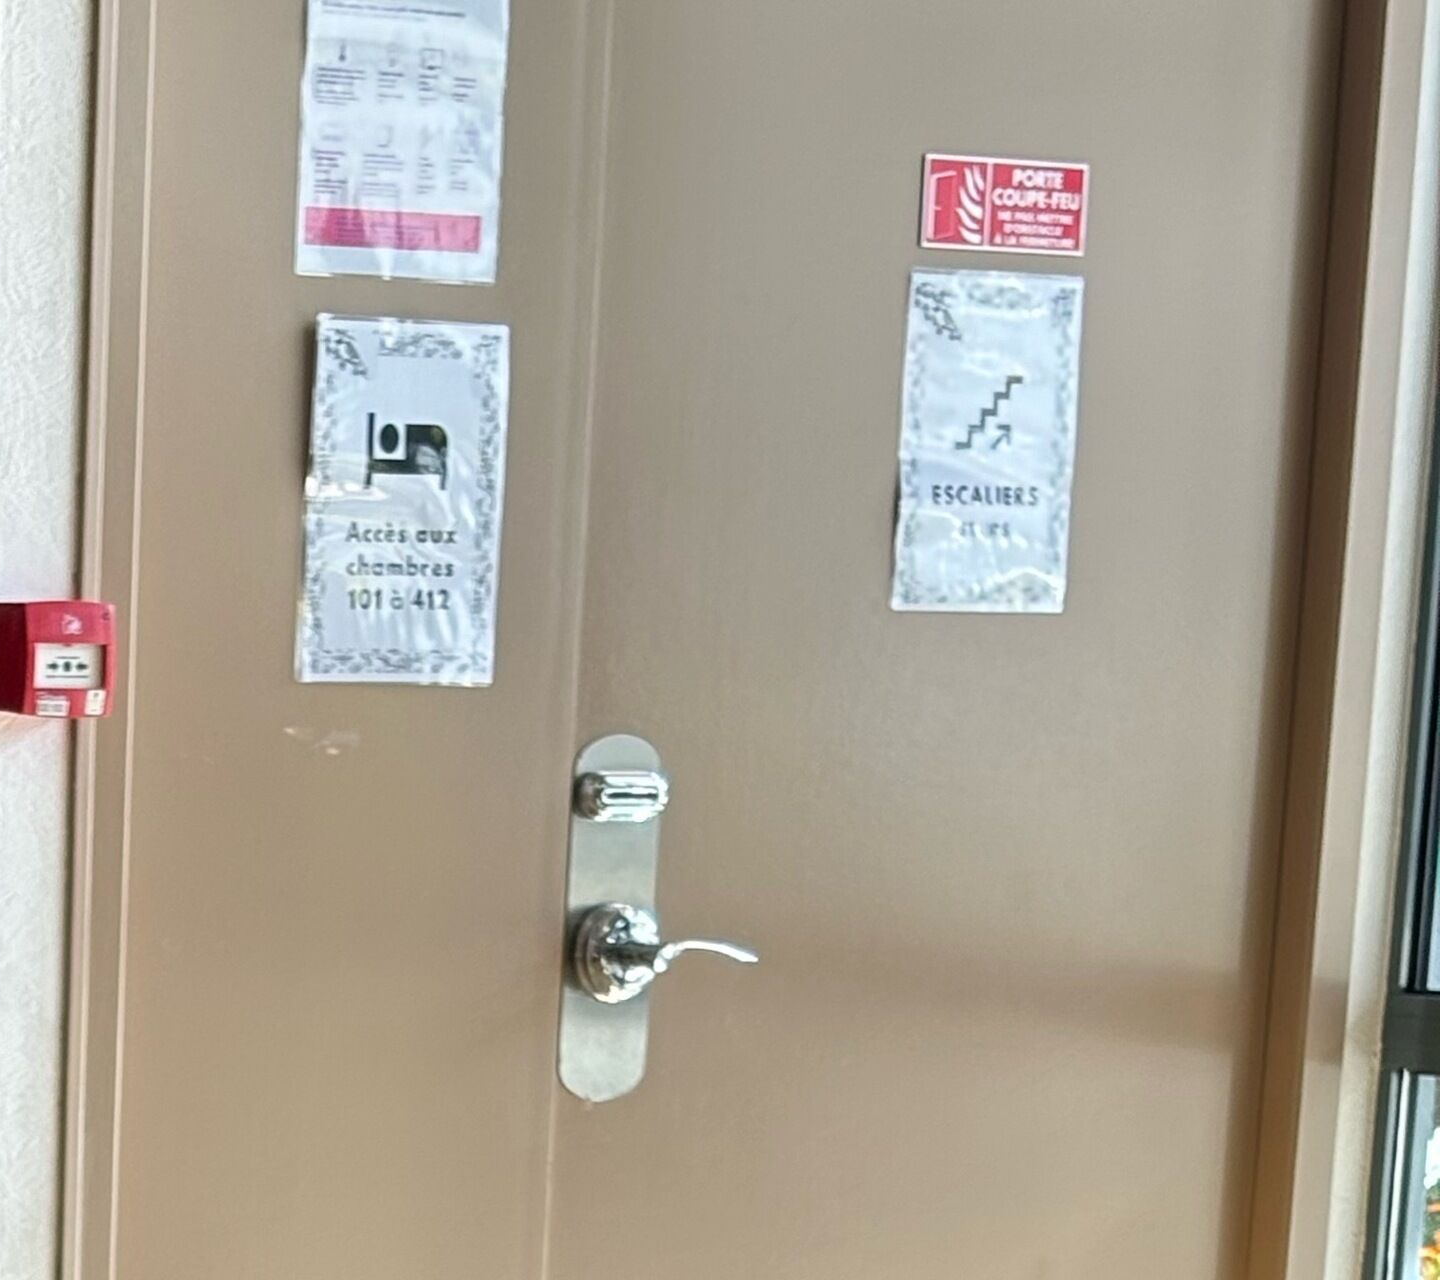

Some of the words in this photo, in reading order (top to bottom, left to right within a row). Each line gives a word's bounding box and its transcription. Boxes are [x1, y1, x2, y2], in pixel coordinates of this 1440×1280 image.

[1011, 168, 1065, 190] PORTE
[991, 187, 1081, 211] COUPE-FEU
[931, 484, 1038, 506] ESCALIERS
[344, 521, 407, 543] Accès
[415, 529, 458, 544] aux
[345, 553, 455, 577] chambres
[347, 588, 383, 610] 101
[410, 588, 451, 610] 412
